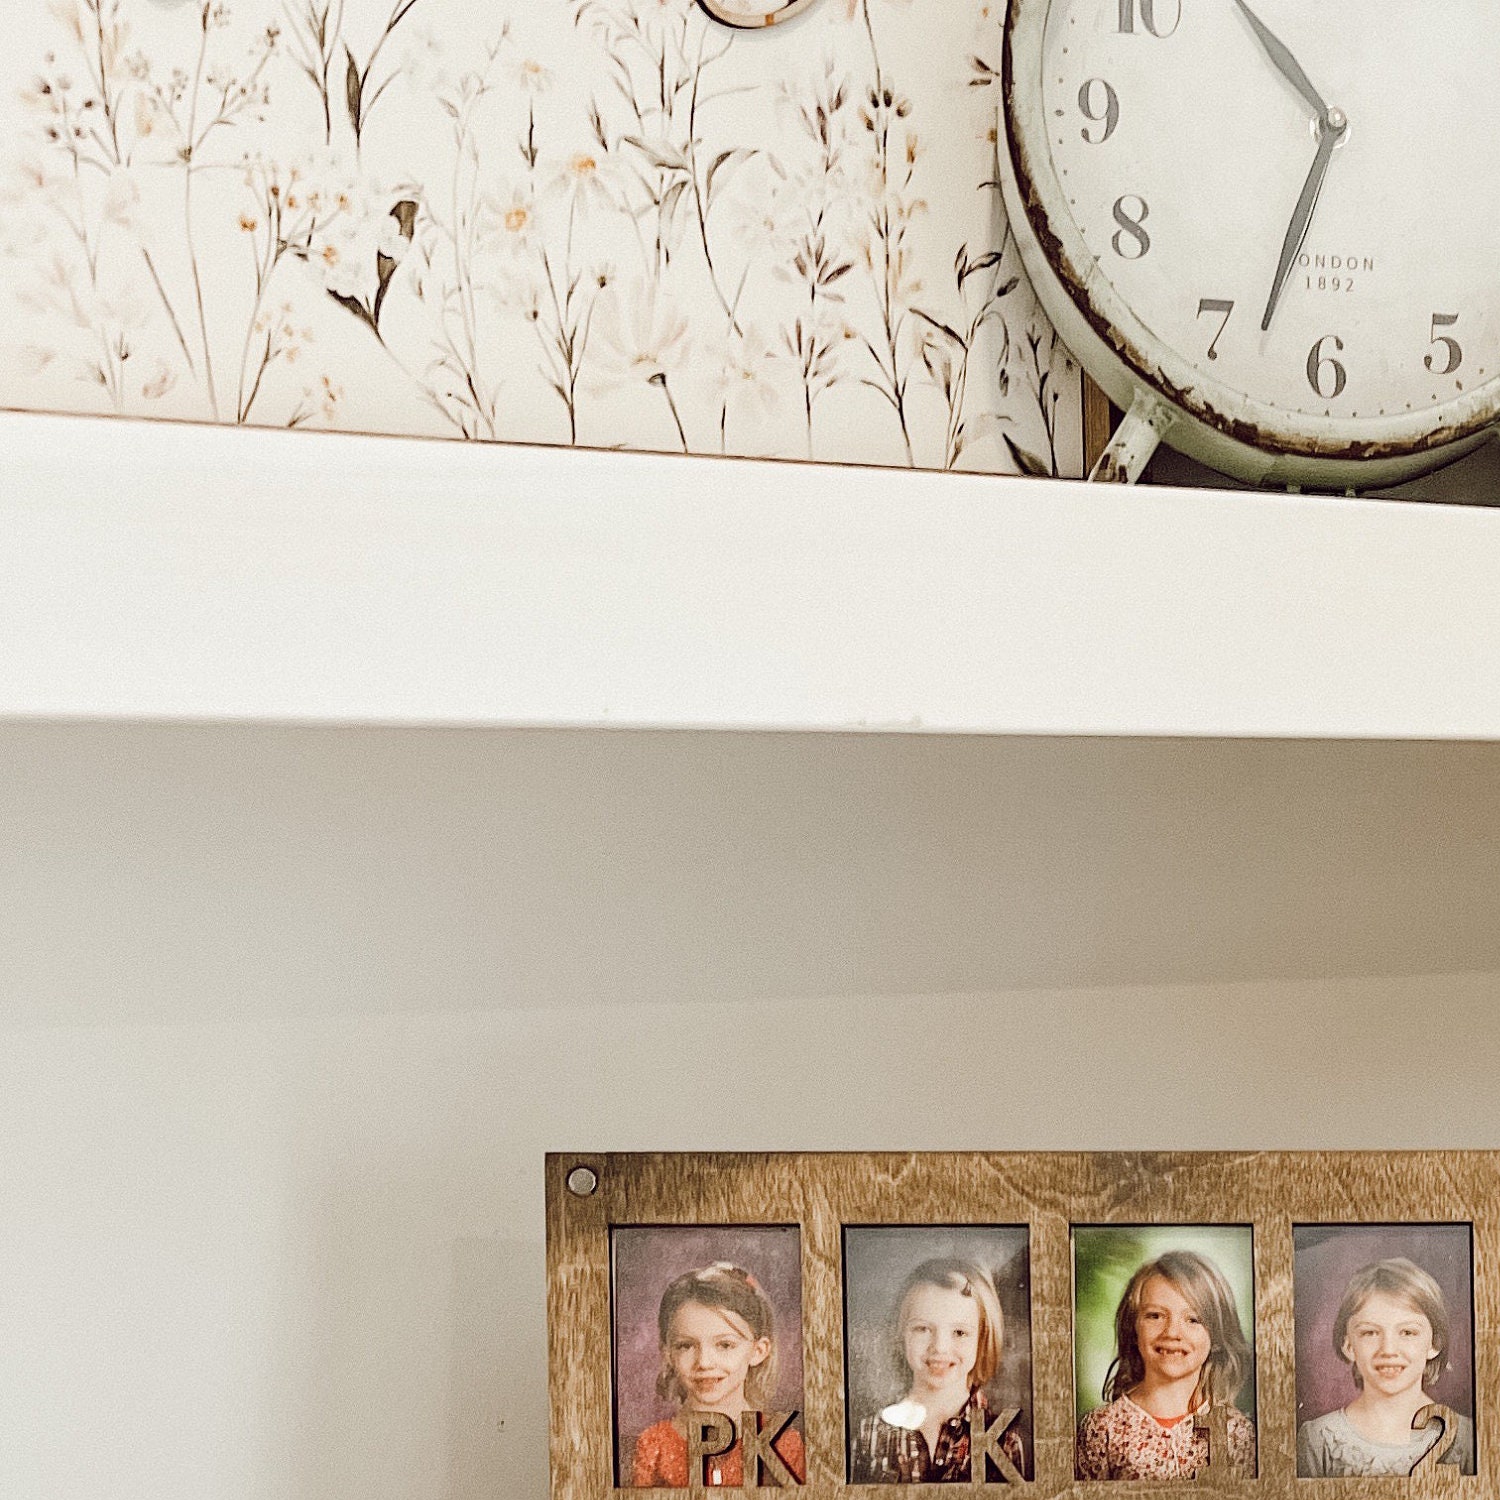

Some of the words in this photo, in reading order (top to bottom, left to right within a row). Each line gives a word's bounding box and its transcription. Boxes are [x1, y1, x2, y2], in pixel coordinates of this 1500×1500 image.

[1078, 78, 1120, 144] 9
[1112, 195, 1151, 260] 8
[1299, 253, 1375, 272] ONDON
[1305, 276, 1355, 293] 1892
[1196, 299, 1235, 361] 7
[1423, 313, 1462, 374] 5
[1307, 335, 1348, 398] 6
[685, 1409, 807, 1488] PK
[970, 1407, 1033, 1485] K
[1192, 1403, 1230, 1479] 1
[1411, 1403, 1462, 1477] 2
